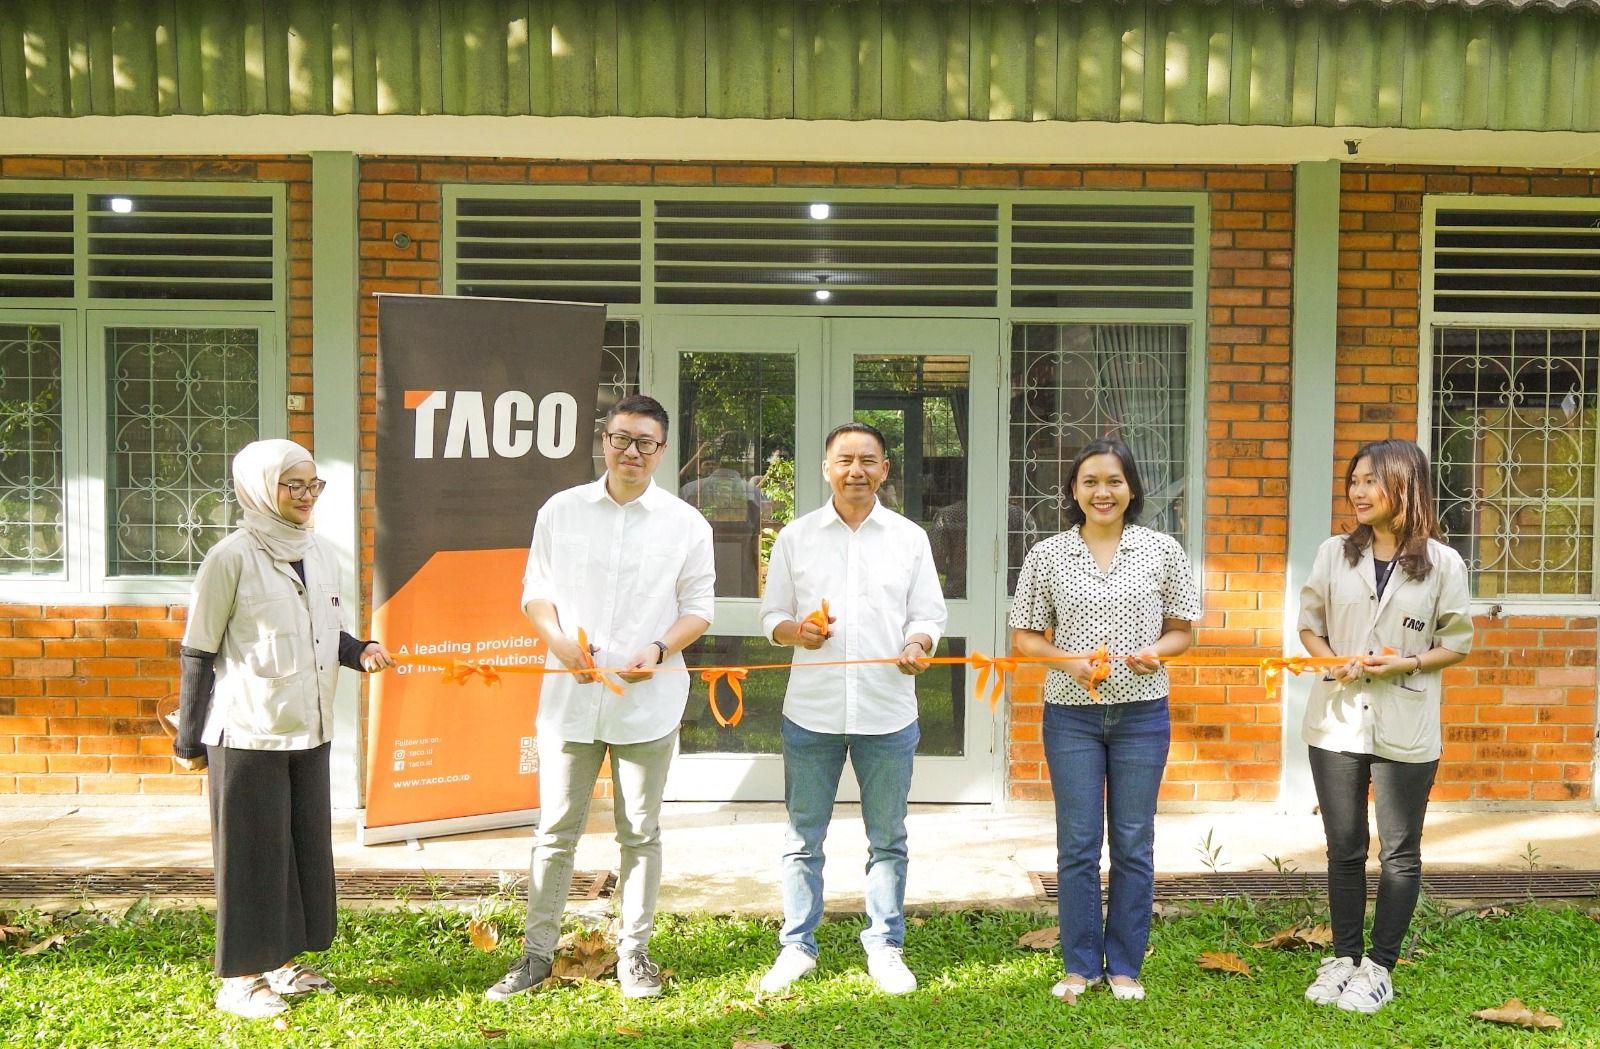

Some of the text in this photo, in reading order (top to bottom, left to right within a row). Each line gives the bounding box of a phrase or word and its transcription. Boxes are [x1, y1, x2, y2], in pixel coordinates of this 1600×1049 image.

[404, 390, 578, 459] TACO
[1402, 614, 1425, 632] TACO
[398, 635, 540, 656] A leading provider
[397, 663, 414, 675] of
[479, 653, 545, 667] solutions
[393, 774, 471, 788] WWW.TACO.CO.ID
